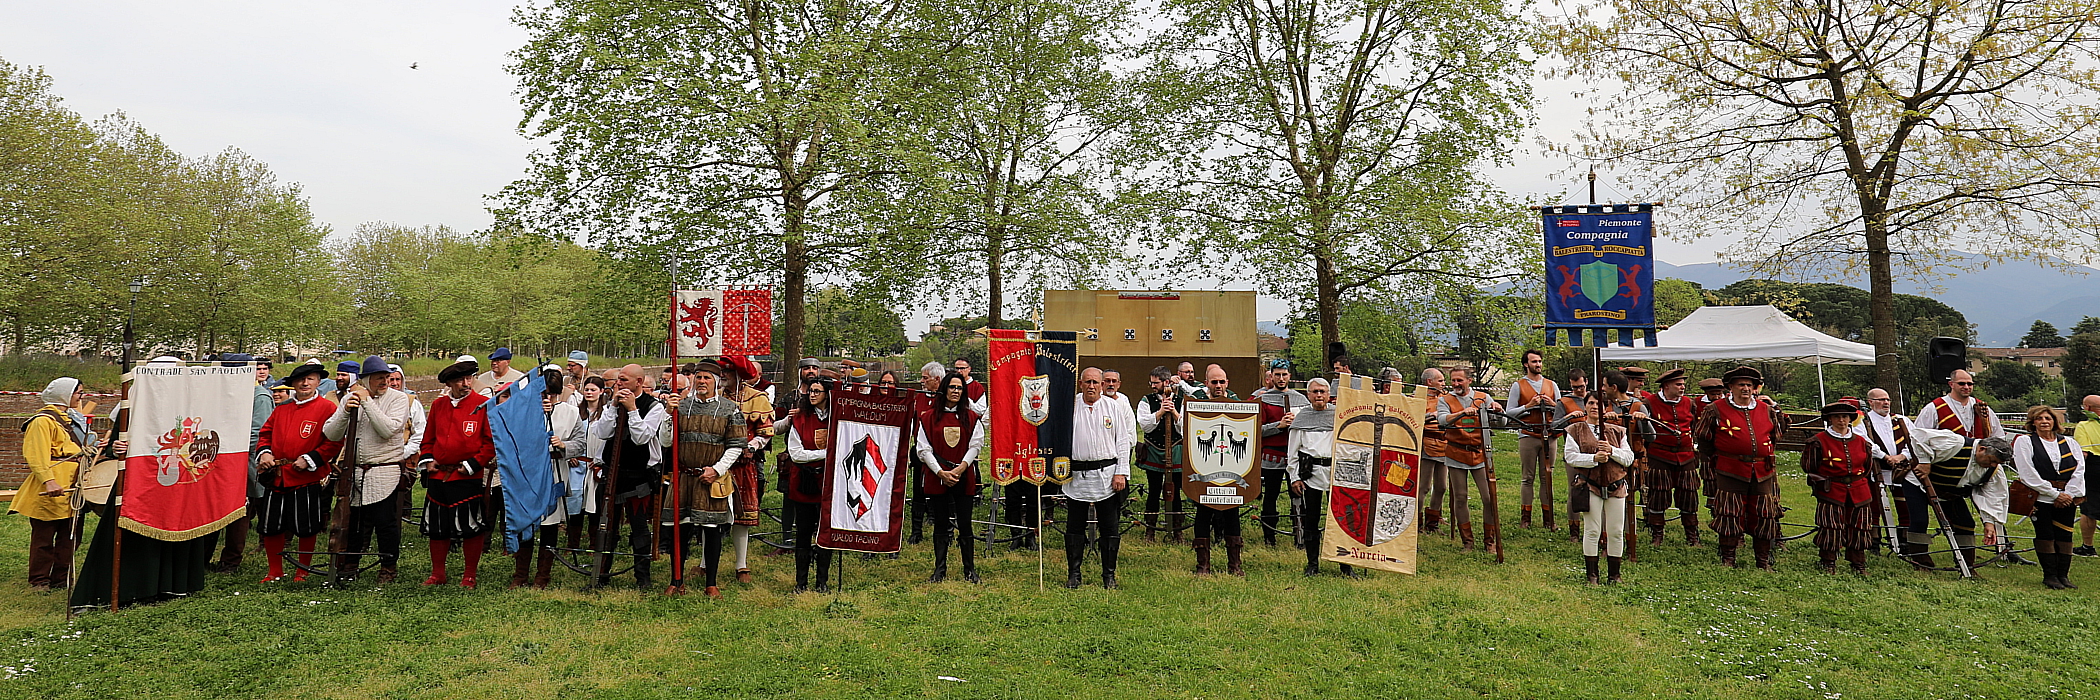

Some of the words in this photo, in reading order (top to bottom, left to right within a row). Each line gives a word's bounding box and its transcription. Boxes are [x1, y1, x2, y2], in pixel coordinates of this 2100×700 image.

[1566, 231, 1628, 241] Compagnia
[1555, 246, 1592, 255] BALESTRIERI
[1604, 246, 1643, 255] ROCCAPIATTA
[991, 347, 1032, 370] Compagnia
[136, 367, 183, 376] CONTRADE
[189, 368, 207, 376] SAN
[211, 367, 252, 375] PAOLINO
[1188, 403, 1224, 411] Compagnia
[1338, 404, 1373, 419] Compagnia
[1201, 496, 1242, 504] Montefalco
[1351, 547, 1386, 562] Norcia
